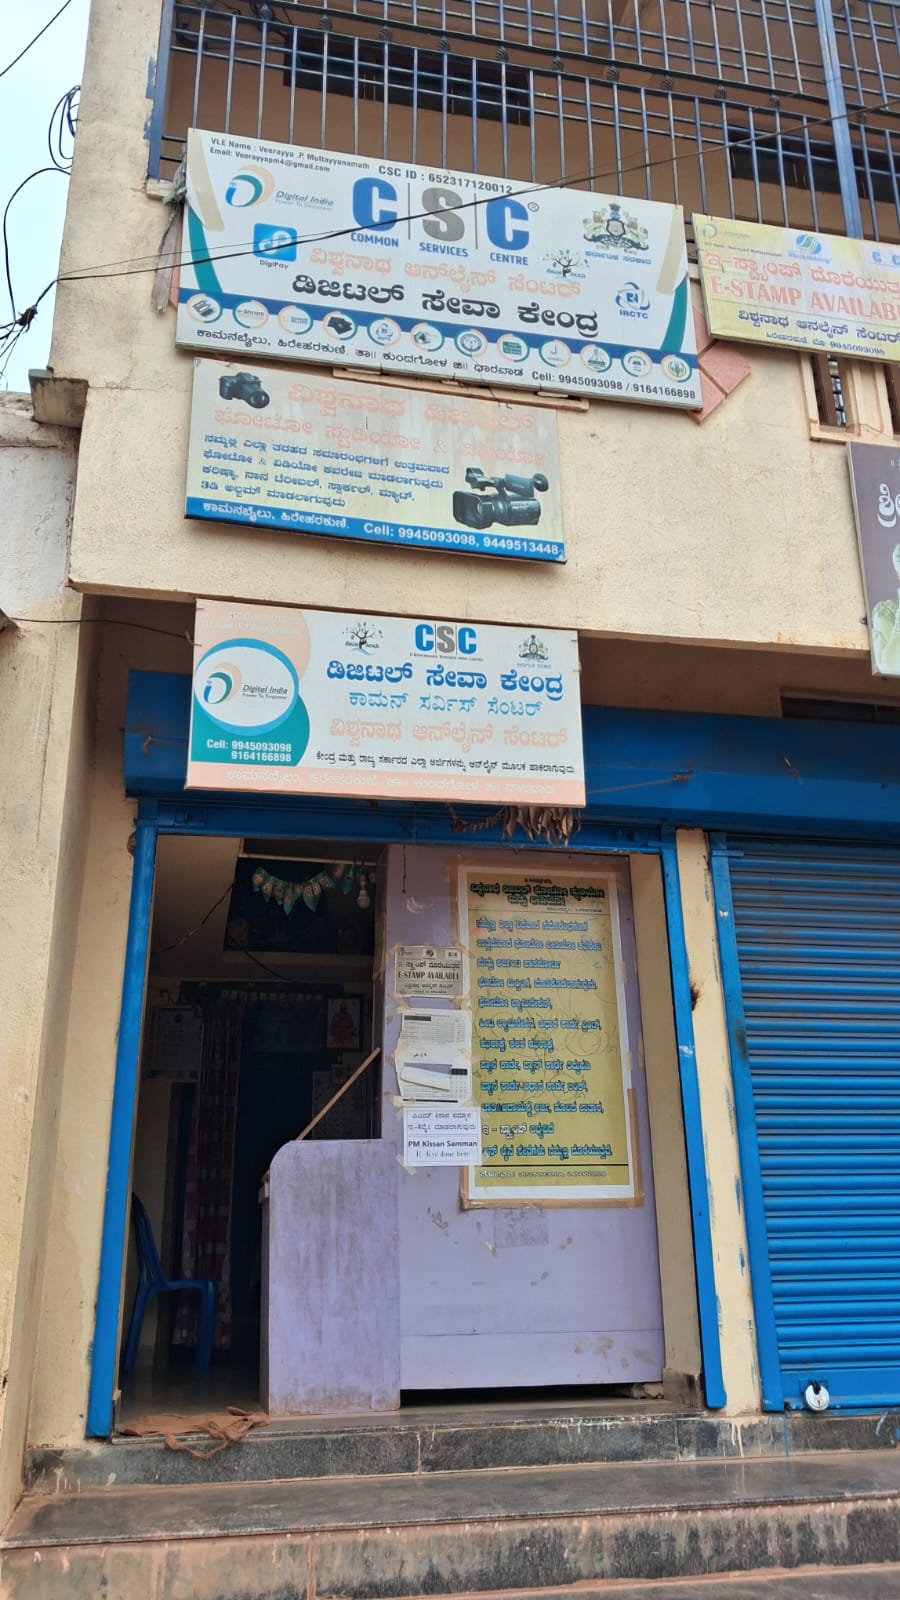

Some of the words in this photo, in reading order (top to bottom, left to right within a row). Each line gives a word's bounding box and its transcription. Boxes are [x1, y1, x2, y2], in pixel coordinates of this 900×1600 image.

[210, 147, 233, 157] Email:
[211, 137, 226, 146] VLE
[229, 141, 251, 151] Name
[259, 145, 294, 158] Veerayya
[378, 165, 401, 178] CSC
[405, 169, 417, 179] ID
[428, 173, 513, 194] 652317120012
[276, 190, 309, 202] Digital
[310, 195, 334, 205] India
[351, 232, 399, 248] COMMON
[419, 241, 469, 258] SERVICES
[260, 260, 288, 269] DigiPay
[490, 252, 528, 266] CENTRE
[310, 247, 392, 277] ವಿಶ್ವನಾಥ
[508, 273, 581, 298] ಸೆಂಟರ್
[709, 275, 803, 306] E-STAMP
[292, 274, 405, 304] ಡಿಜಿಟಲ್
[422, 289, 501, 319] ಸೇವಾ
[517, 302, 599, 338] ಕೇಂದ್ರ
[619, 309, 649, 319] IRCTC
[382, 352, 448, 368] ಕುಂದಗೋಳ
[474, 362, 524, 377] ಧಾರವಾಡ
[532, 370, 555, 382] Cell:
[558, 374, 623, 390] 9945093098
[633, 383, 696, 399] 9164166898
[433, 440, 448, 455] &
[259, 457, 267, 466] &
[363, 523, 394, 537] Cell:
[398, 528, 480, 547] 9945093098,
[415, 623, 477, 655] CSC
[326, 659, 413, 684] ಡಿಜಿಟಲ್
[426, 664, 488, 690] ಸೇವಾ
[500, 669, 564, 702] ಕೇಂದ್ರ
[242, 684, 268, 695] Digital
[269, 686, 288, 696] India
[349, 691, 408, 709] ಕಾಮನ್
[419, 693, 477, 713] ಸರ್ವಿಸ್
[487, 696, 543, 717] ಸೆಂಟರ್
[330, 717, 402, 748] ವಿಶ್ವನಾಥ
[503, 725, 567, 748] ಸೆಂಟರ್
[207, 738, 228, 750] Cell:
[231, 740, 292, 753] 9945093098
[231, 750, 292, 762] 9164166898
